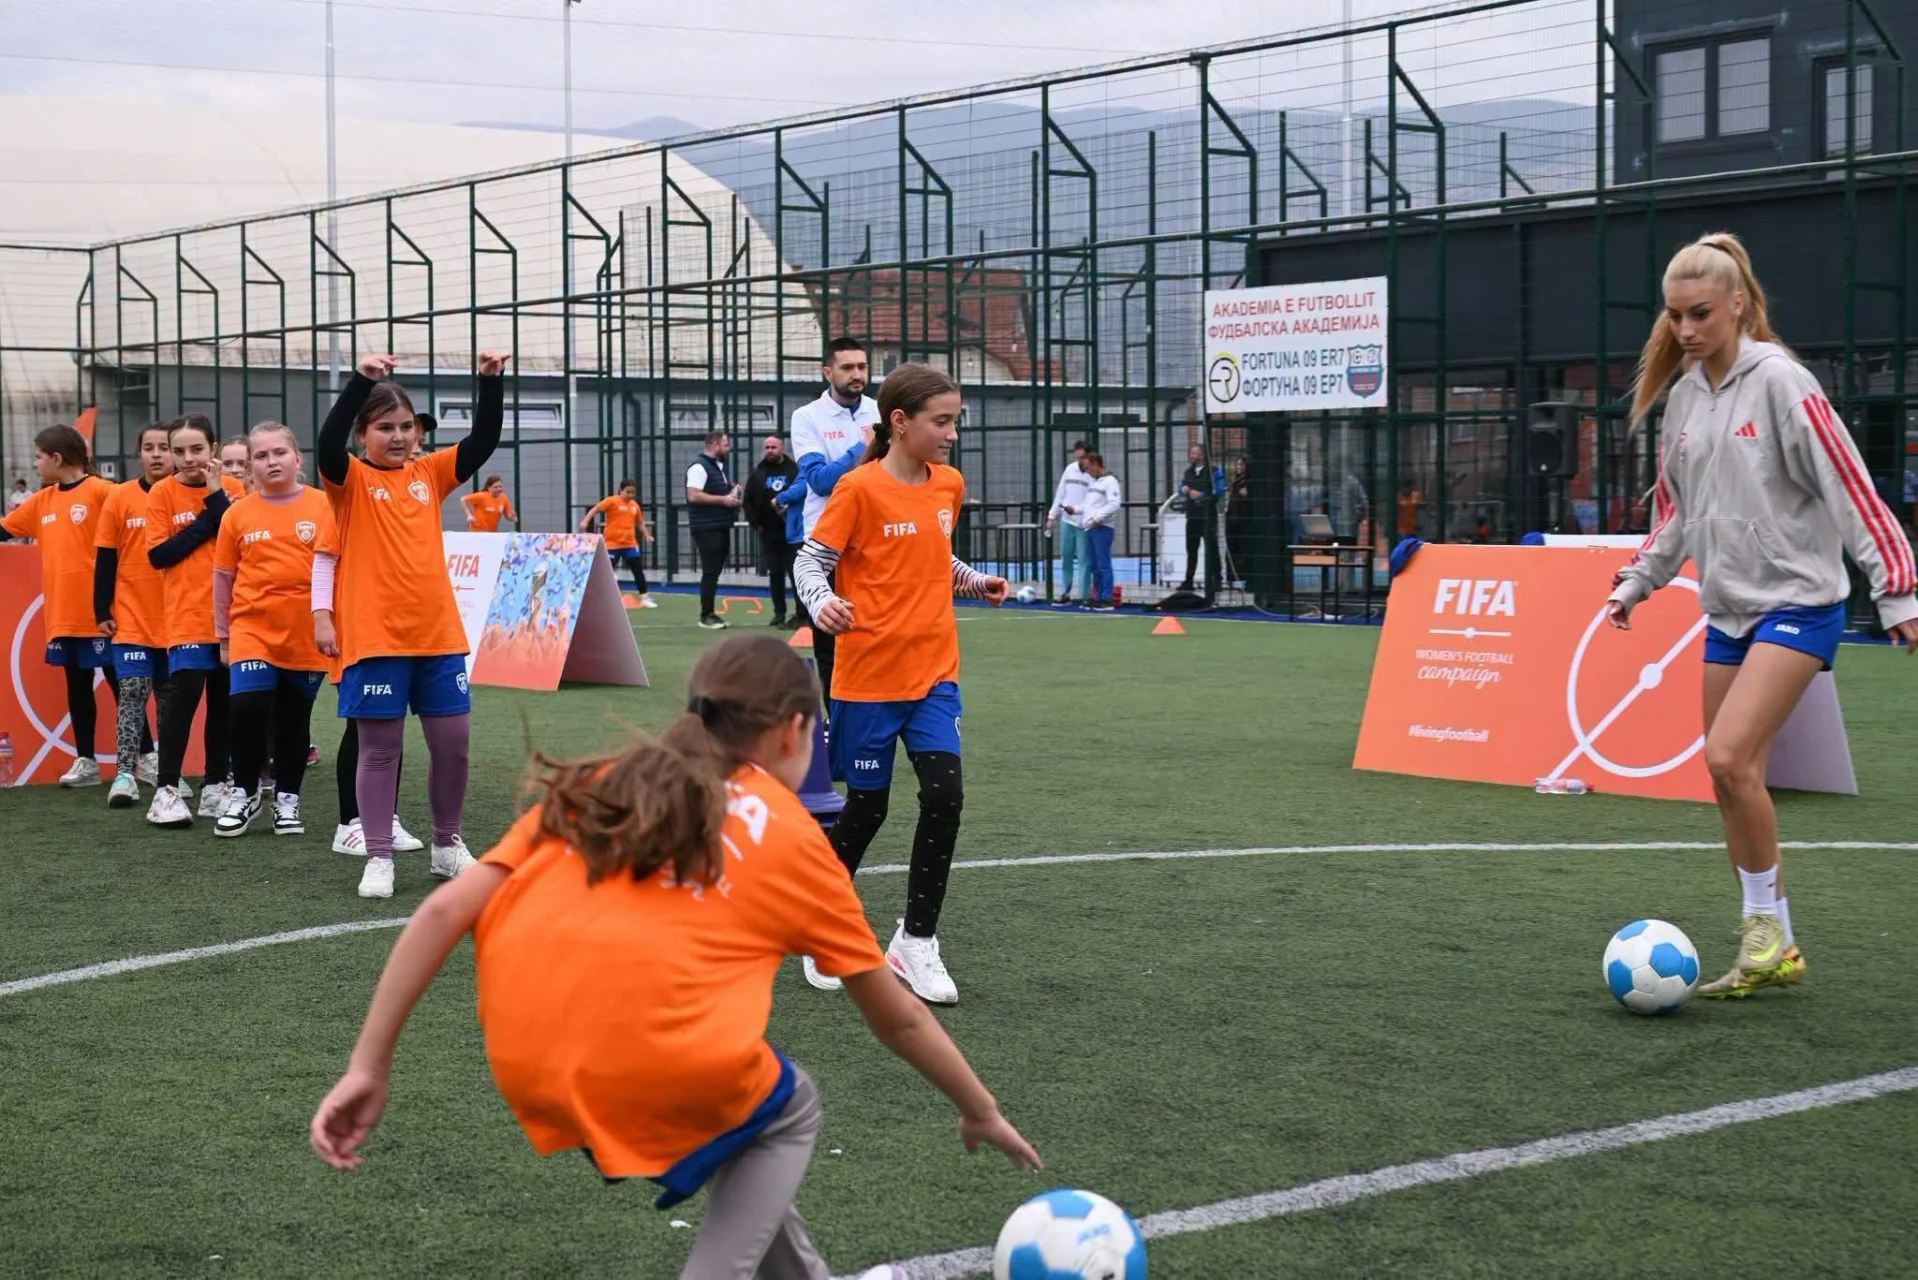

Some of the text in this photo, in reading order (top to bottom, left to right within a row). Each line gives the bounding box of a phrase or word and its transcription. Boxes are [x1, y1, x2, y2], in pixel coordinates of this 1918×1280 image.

[1213, 292, 1376, 318] AKADEMIA E FUTBOLLIT
[1208, 314, 1380, 341] ФУДБАЛСКА АКАДЕМИЈА
[1242, 348, 1345, 370] FORTUNA 09 ER7
[1242, 376, 1301, 398] ФОРТУНА
[1304, 376, 1317, 395] 09
[824, 430, 846, 440] FIFA
[244, 530, 272, 545] FIFA
[884, 521, 918, 537] FIFA
[447, 554, 480, 578] FIFA
[1433, 578, 1516, 617] FIFA
[124, 652, 147, 661] FIFA
[1415, 648, 1514, 665] WOMEN'S FOOTBALL
[241, 659, 268, 672] FIFA
[1417, 664, 1501, 690] campaign
[363, 684, 393, 696] FIFA
[1408, 724, 1490, 742] #livingfootball
[854, 759, 880, 770] FIFA
